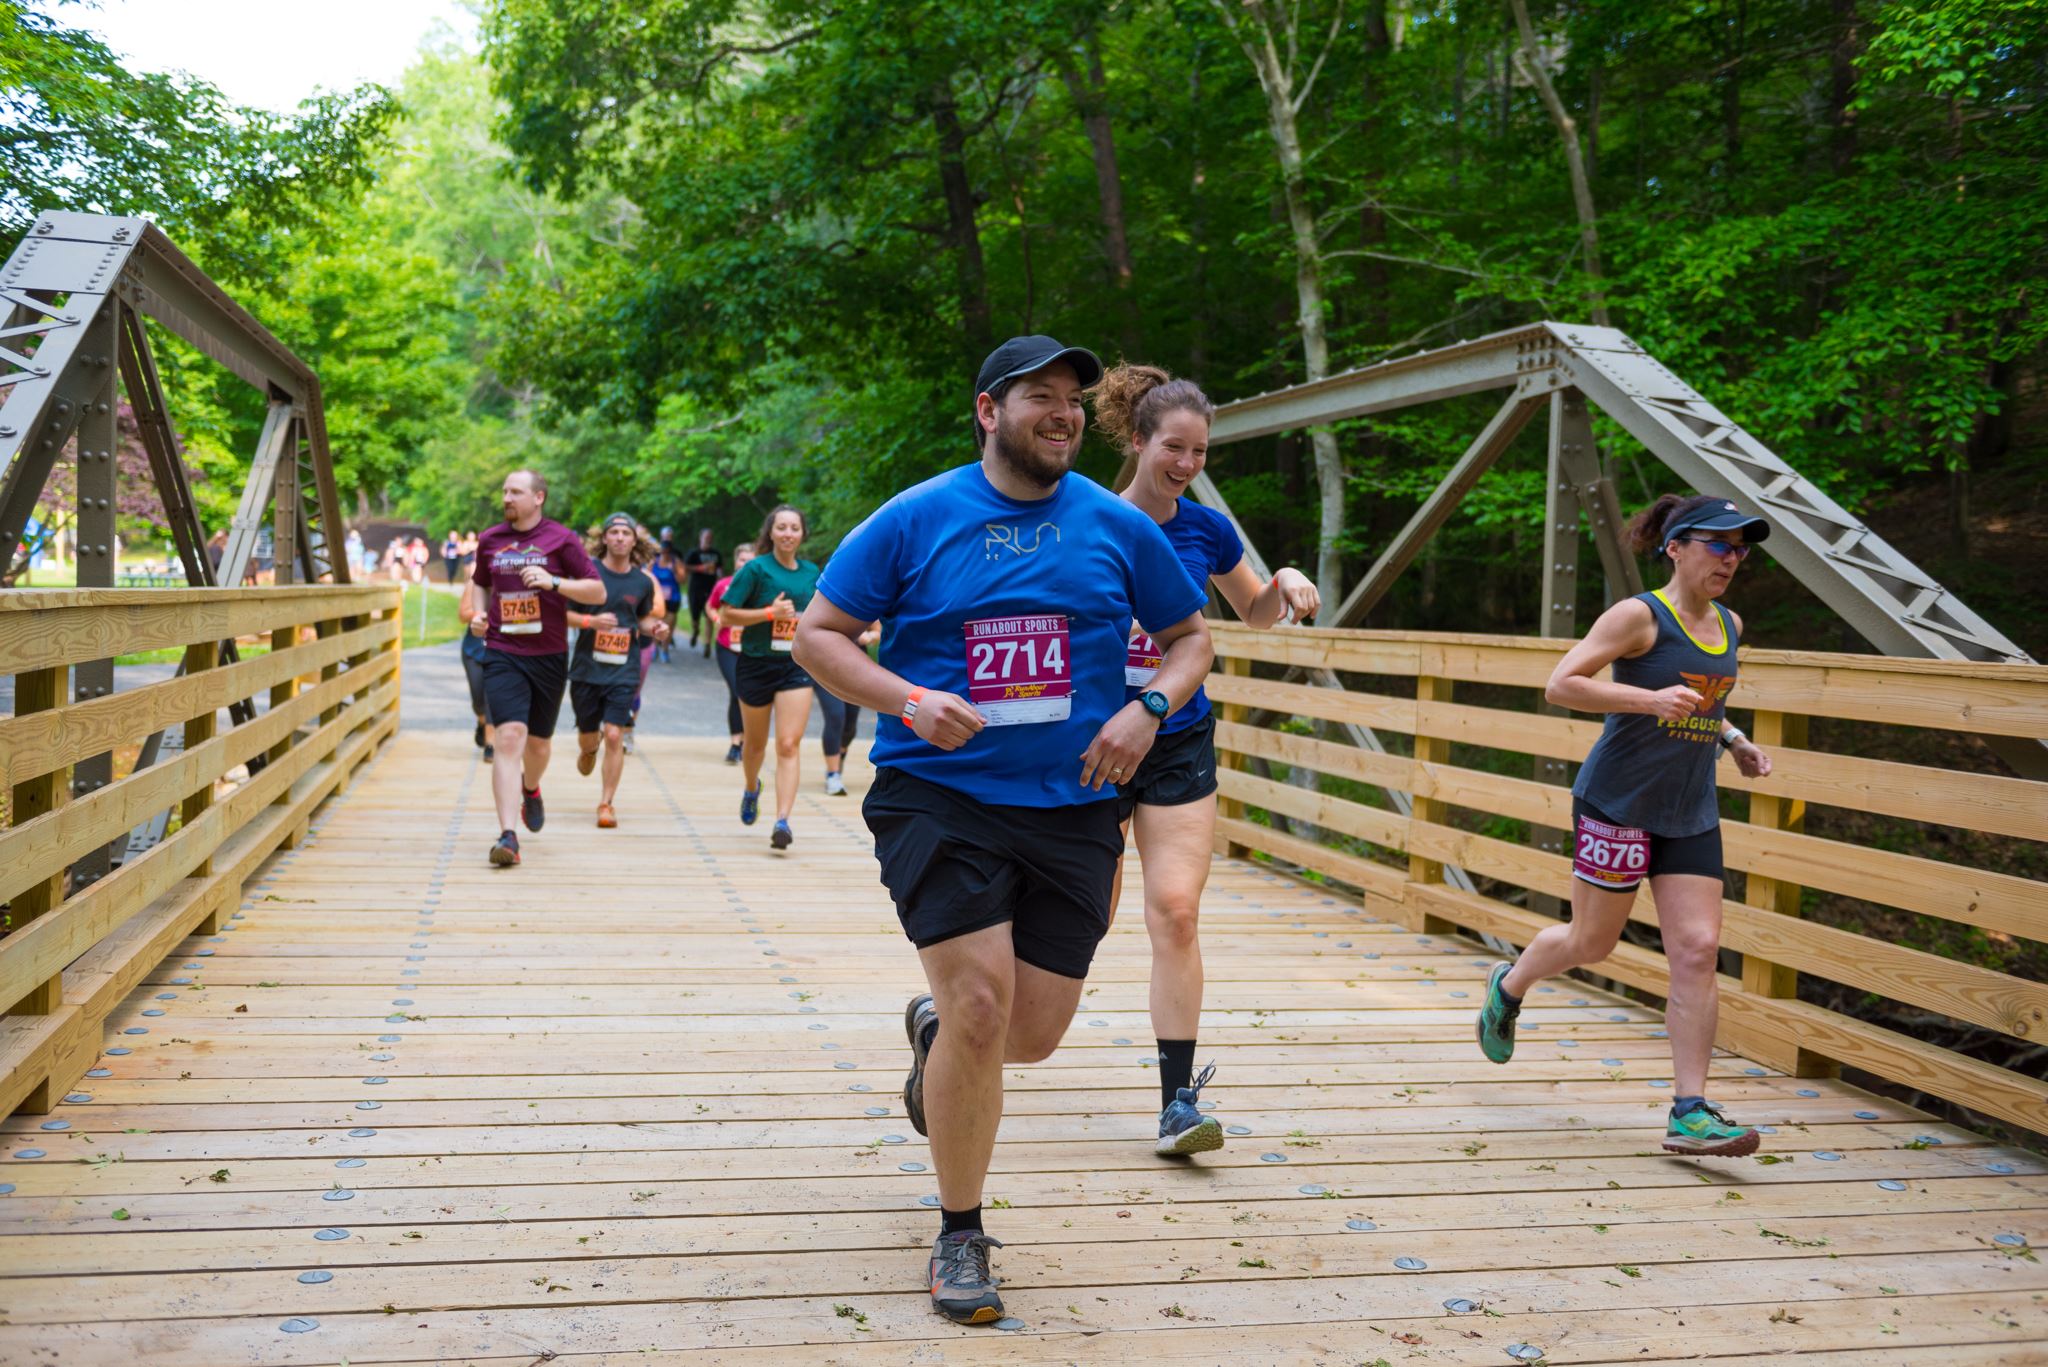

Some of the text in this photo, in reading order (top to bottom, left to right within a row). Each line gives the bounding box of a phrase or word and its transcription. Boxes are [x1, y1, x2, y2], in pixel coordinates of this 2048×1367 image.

[986, 522, 1060, 556] RUN
[526, 557, 548, 565] LAKE
[502, 601, 536, 617] 5745
[775, 620, 798, 633] 574
[973, 618, 1059, 636] RUNABOUT SPORTS
[598, 633, 628, 649] 5746
[972, 638, 1065, 681] 2714
[1657, 716, 1721, 732] FERGUSO
[1668, 729, 1716, 743] FITNESS
[1583, 819, 1644, 839] RUNABOUT SPORTS
[1579, 833, 1646, 869] 2676
